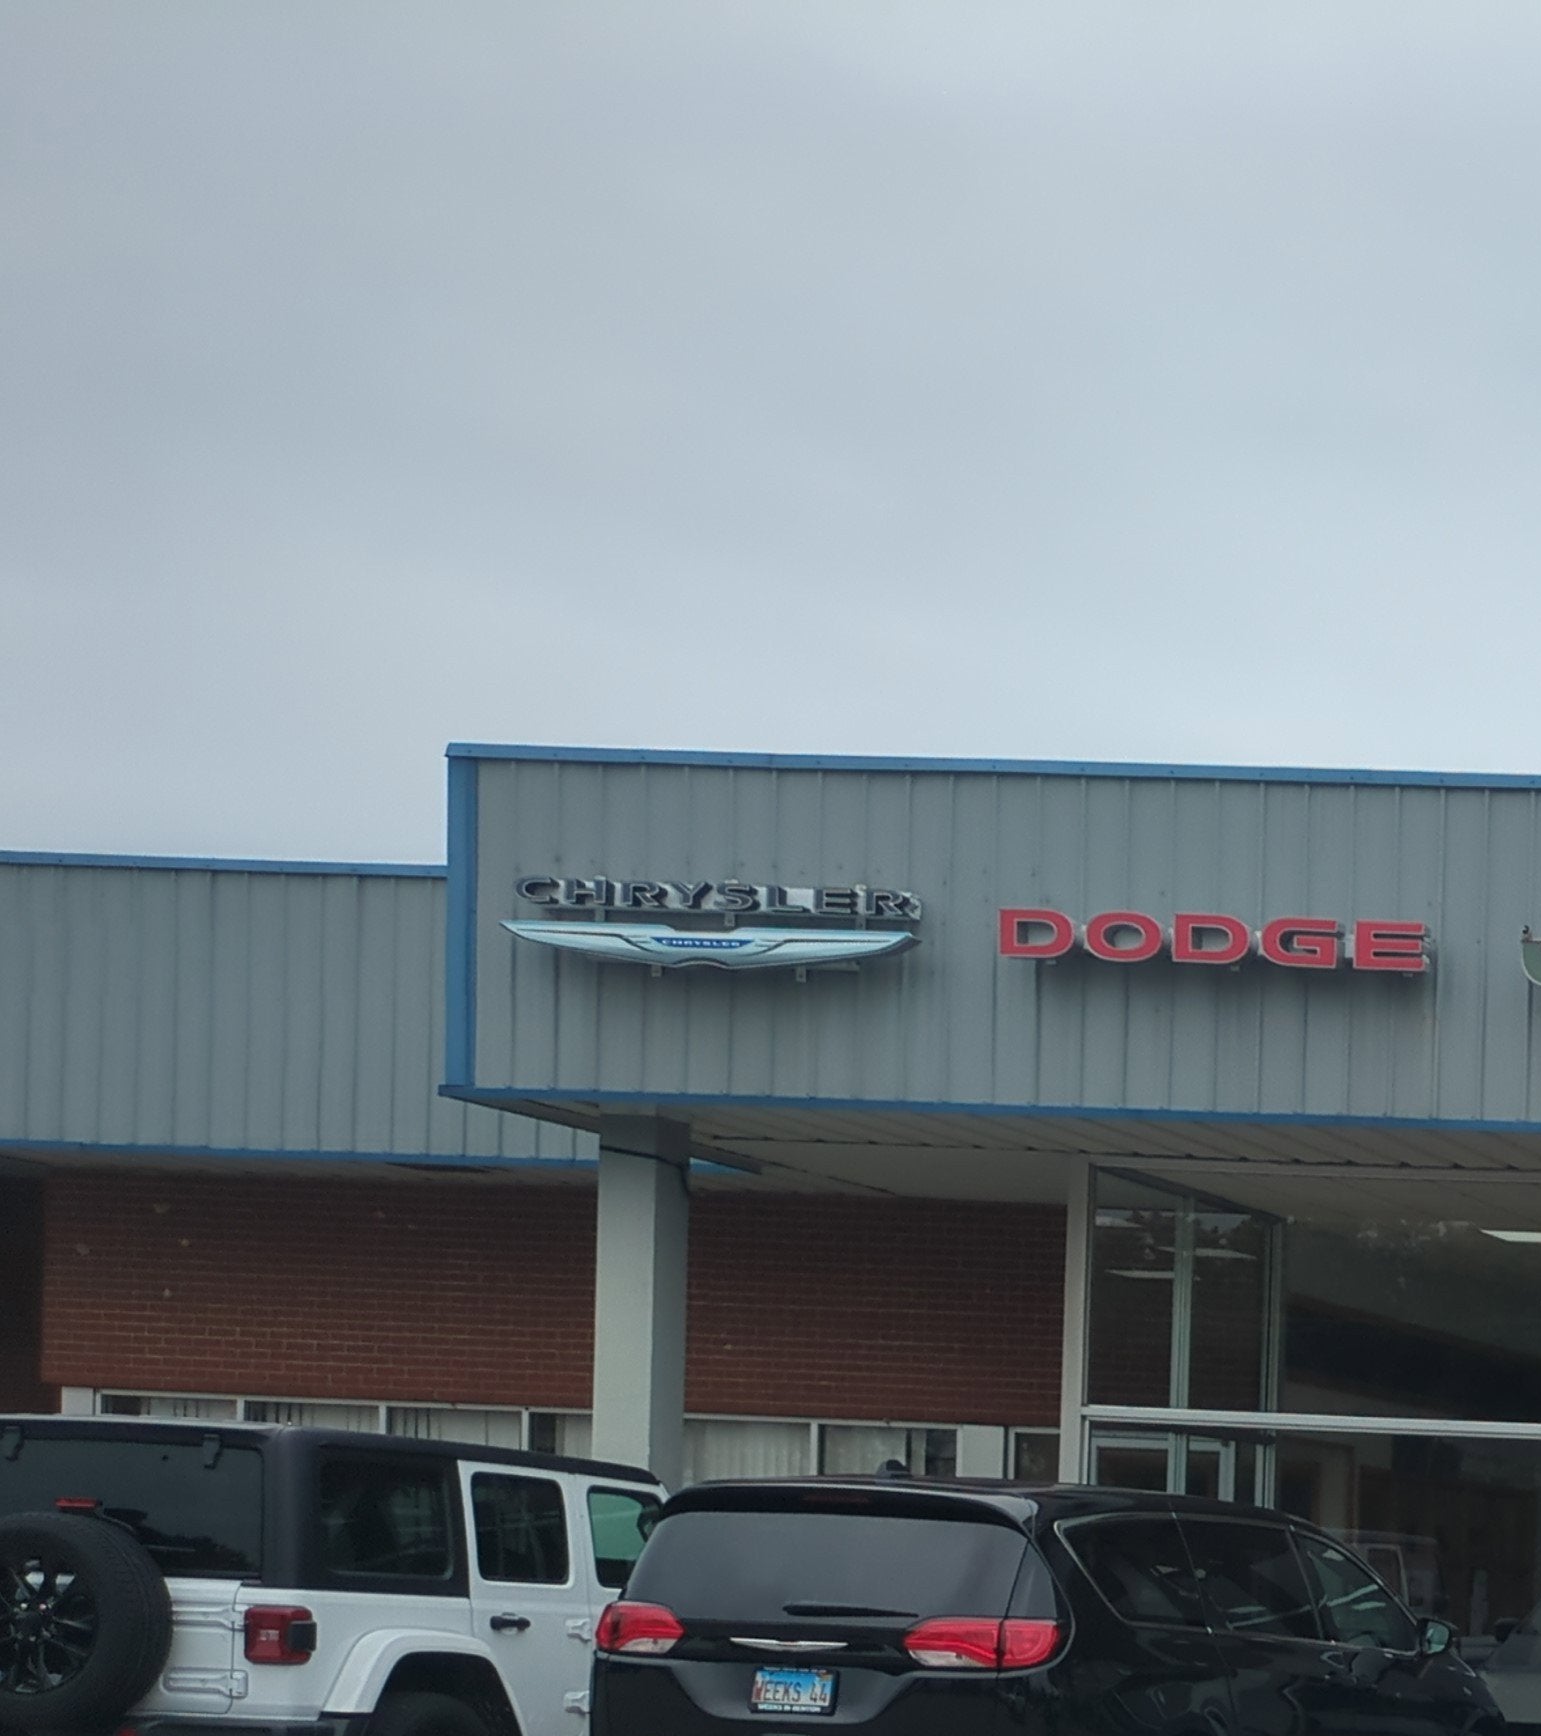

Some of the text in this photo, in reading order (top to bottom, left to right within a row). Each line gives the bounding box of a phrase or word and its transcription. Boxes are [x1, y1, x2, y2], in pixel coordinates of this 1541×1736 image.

[516, 875, 920, 918] CHRYSLER
[999, 908, 1428, 970] DODGE
[752, 1679, 828, 1704] WEEKS 44
